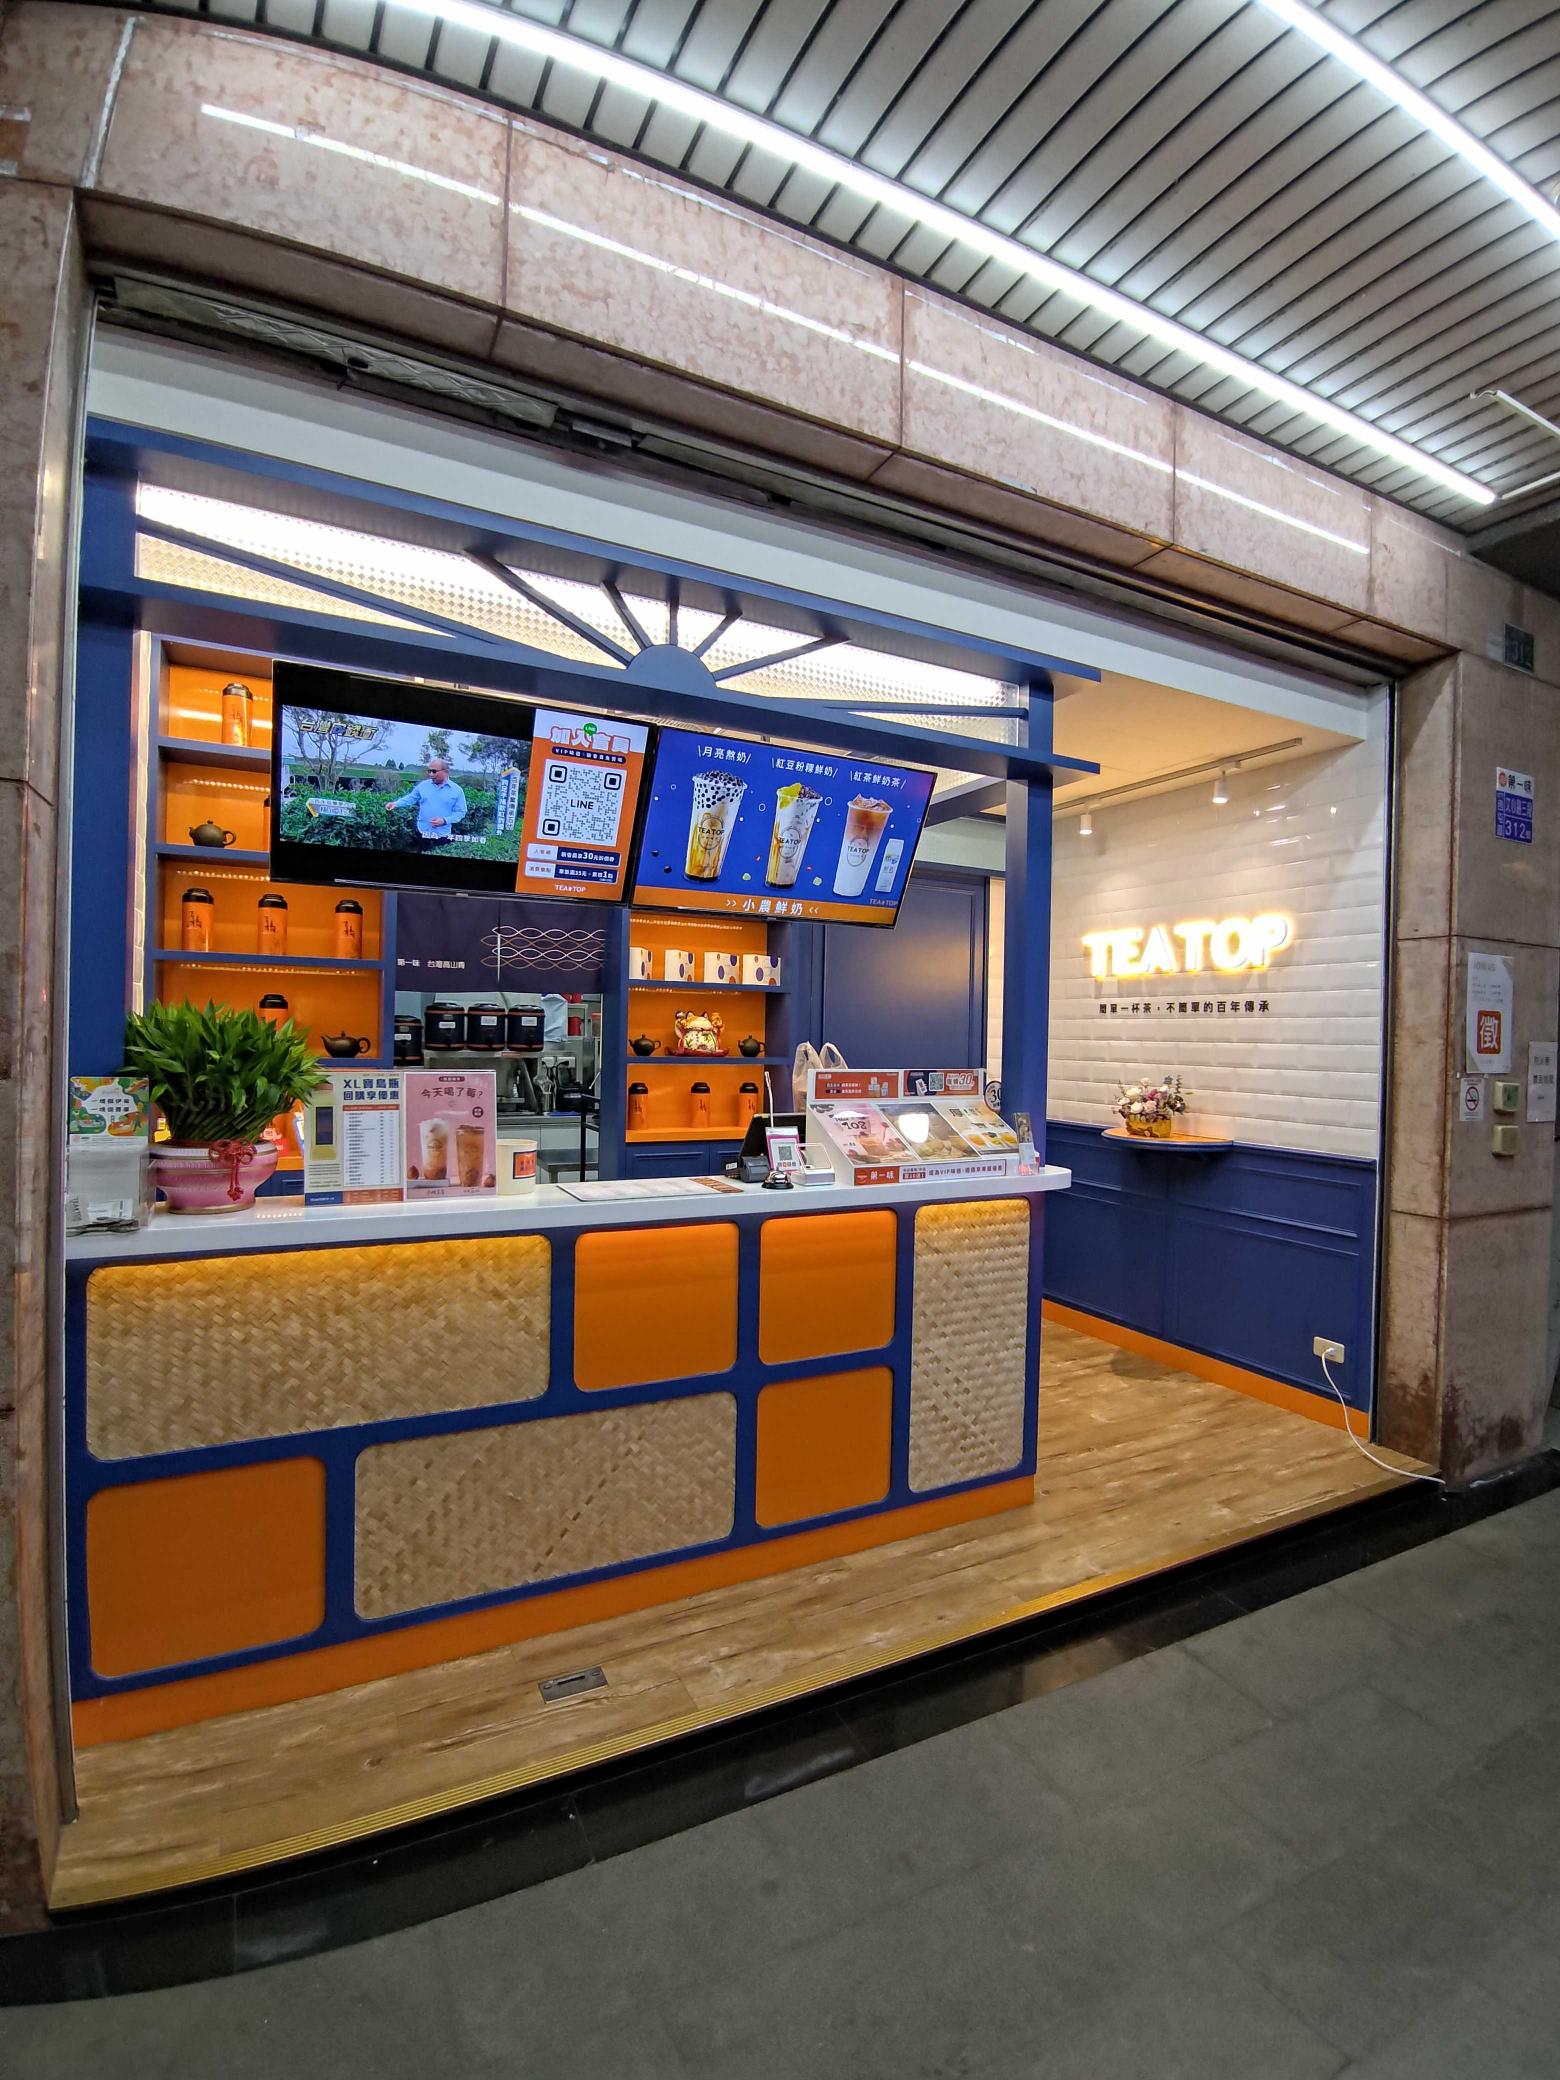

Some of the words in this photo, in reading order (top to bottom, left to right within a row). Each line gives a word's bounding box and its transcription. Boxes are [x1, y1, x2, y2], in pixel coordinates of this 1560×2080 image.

[550, 726, 631, 754] 加入會員
[570, 798, 594, 811] LINE
[742, 898, 804, 915] 小農鮮奶
[1083, 916, 1289, 977] TEATOP
[1099, 1000, 1270, 1015] 簡單一杯茶，不簡單的百年傳承
[1480, 1015, 1499, 1050] 徵
[870, 1170, 894, 1181] 第一味
